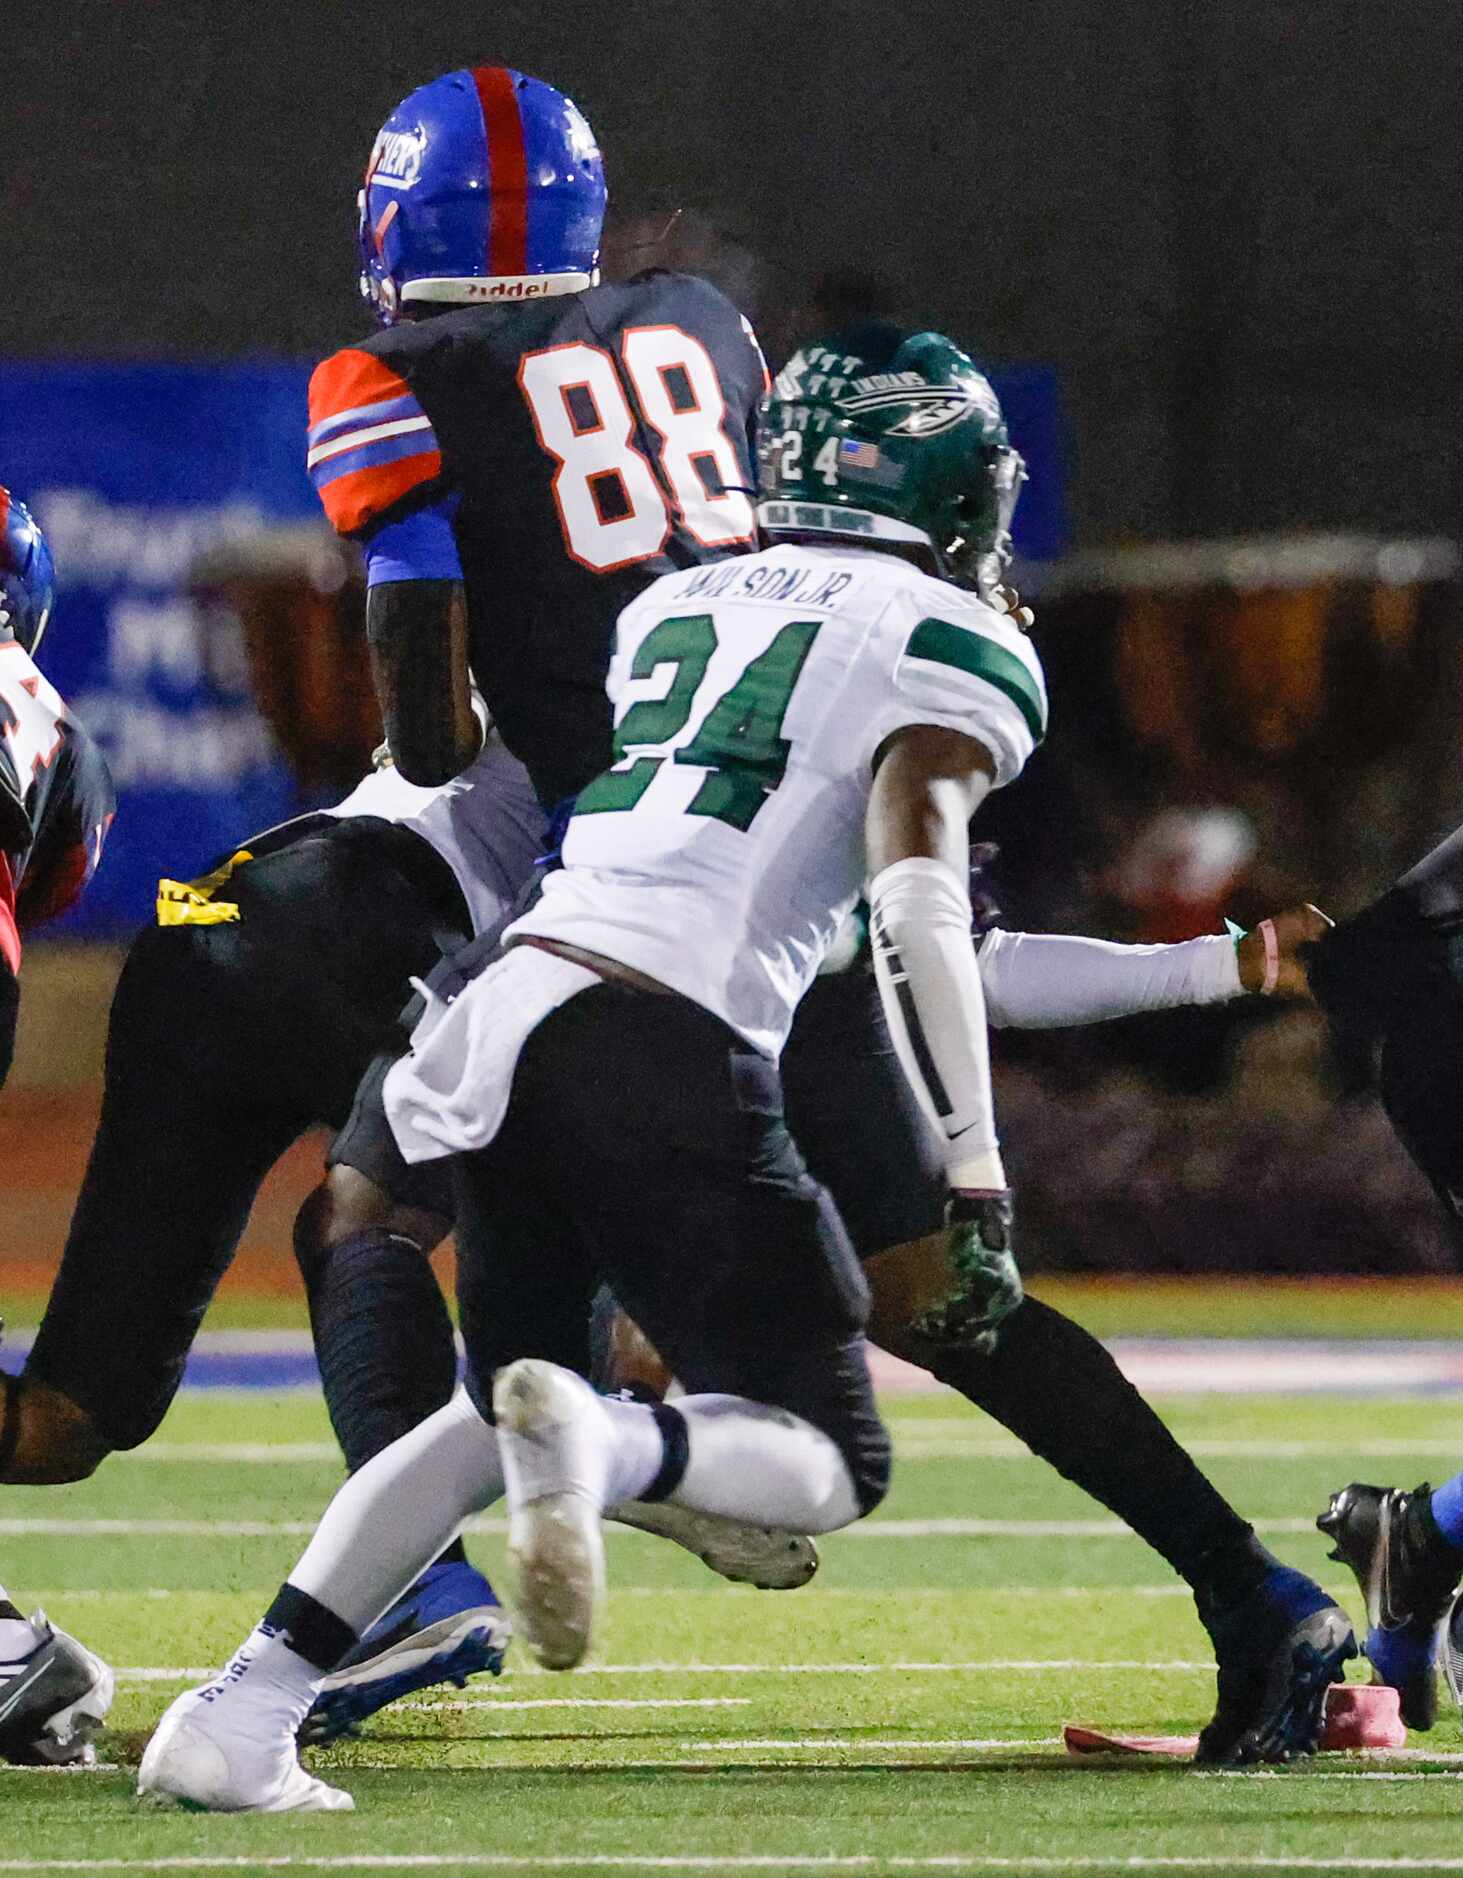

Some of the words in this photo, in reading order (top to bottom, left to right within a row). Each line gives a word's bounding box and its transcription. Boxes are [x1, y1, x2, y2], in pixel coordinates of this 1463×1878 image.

[516, 324, 756, 572] 88
[673, 566, 812, 601] WILSON
[573, 614, 824, 833] 24
